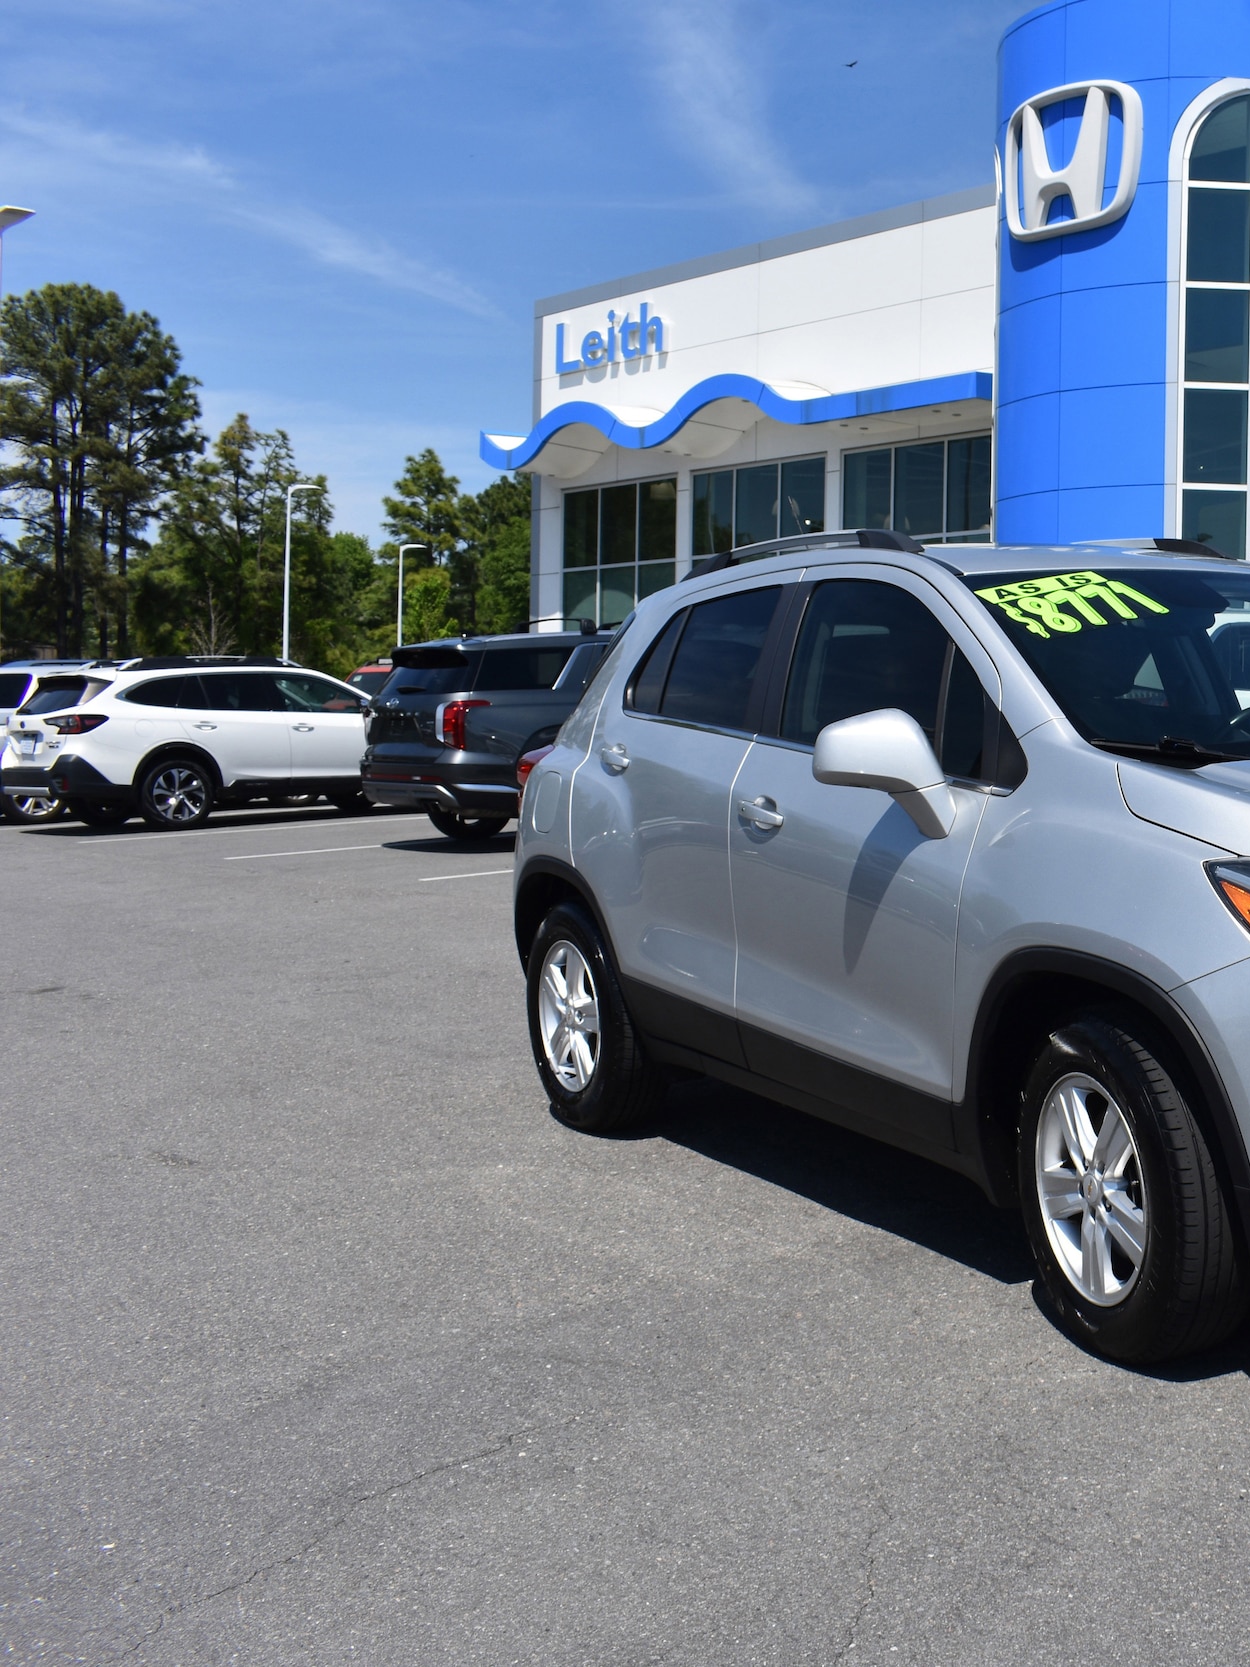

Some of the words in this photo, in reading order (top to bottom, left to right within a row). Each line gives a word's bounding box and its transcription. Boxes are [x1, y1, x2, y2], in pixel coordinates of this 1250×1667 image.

[556, 302, 664, 375] Leith
[994, 583, 1042, 600] AS
[1055, 574, 1092, 588] IS
